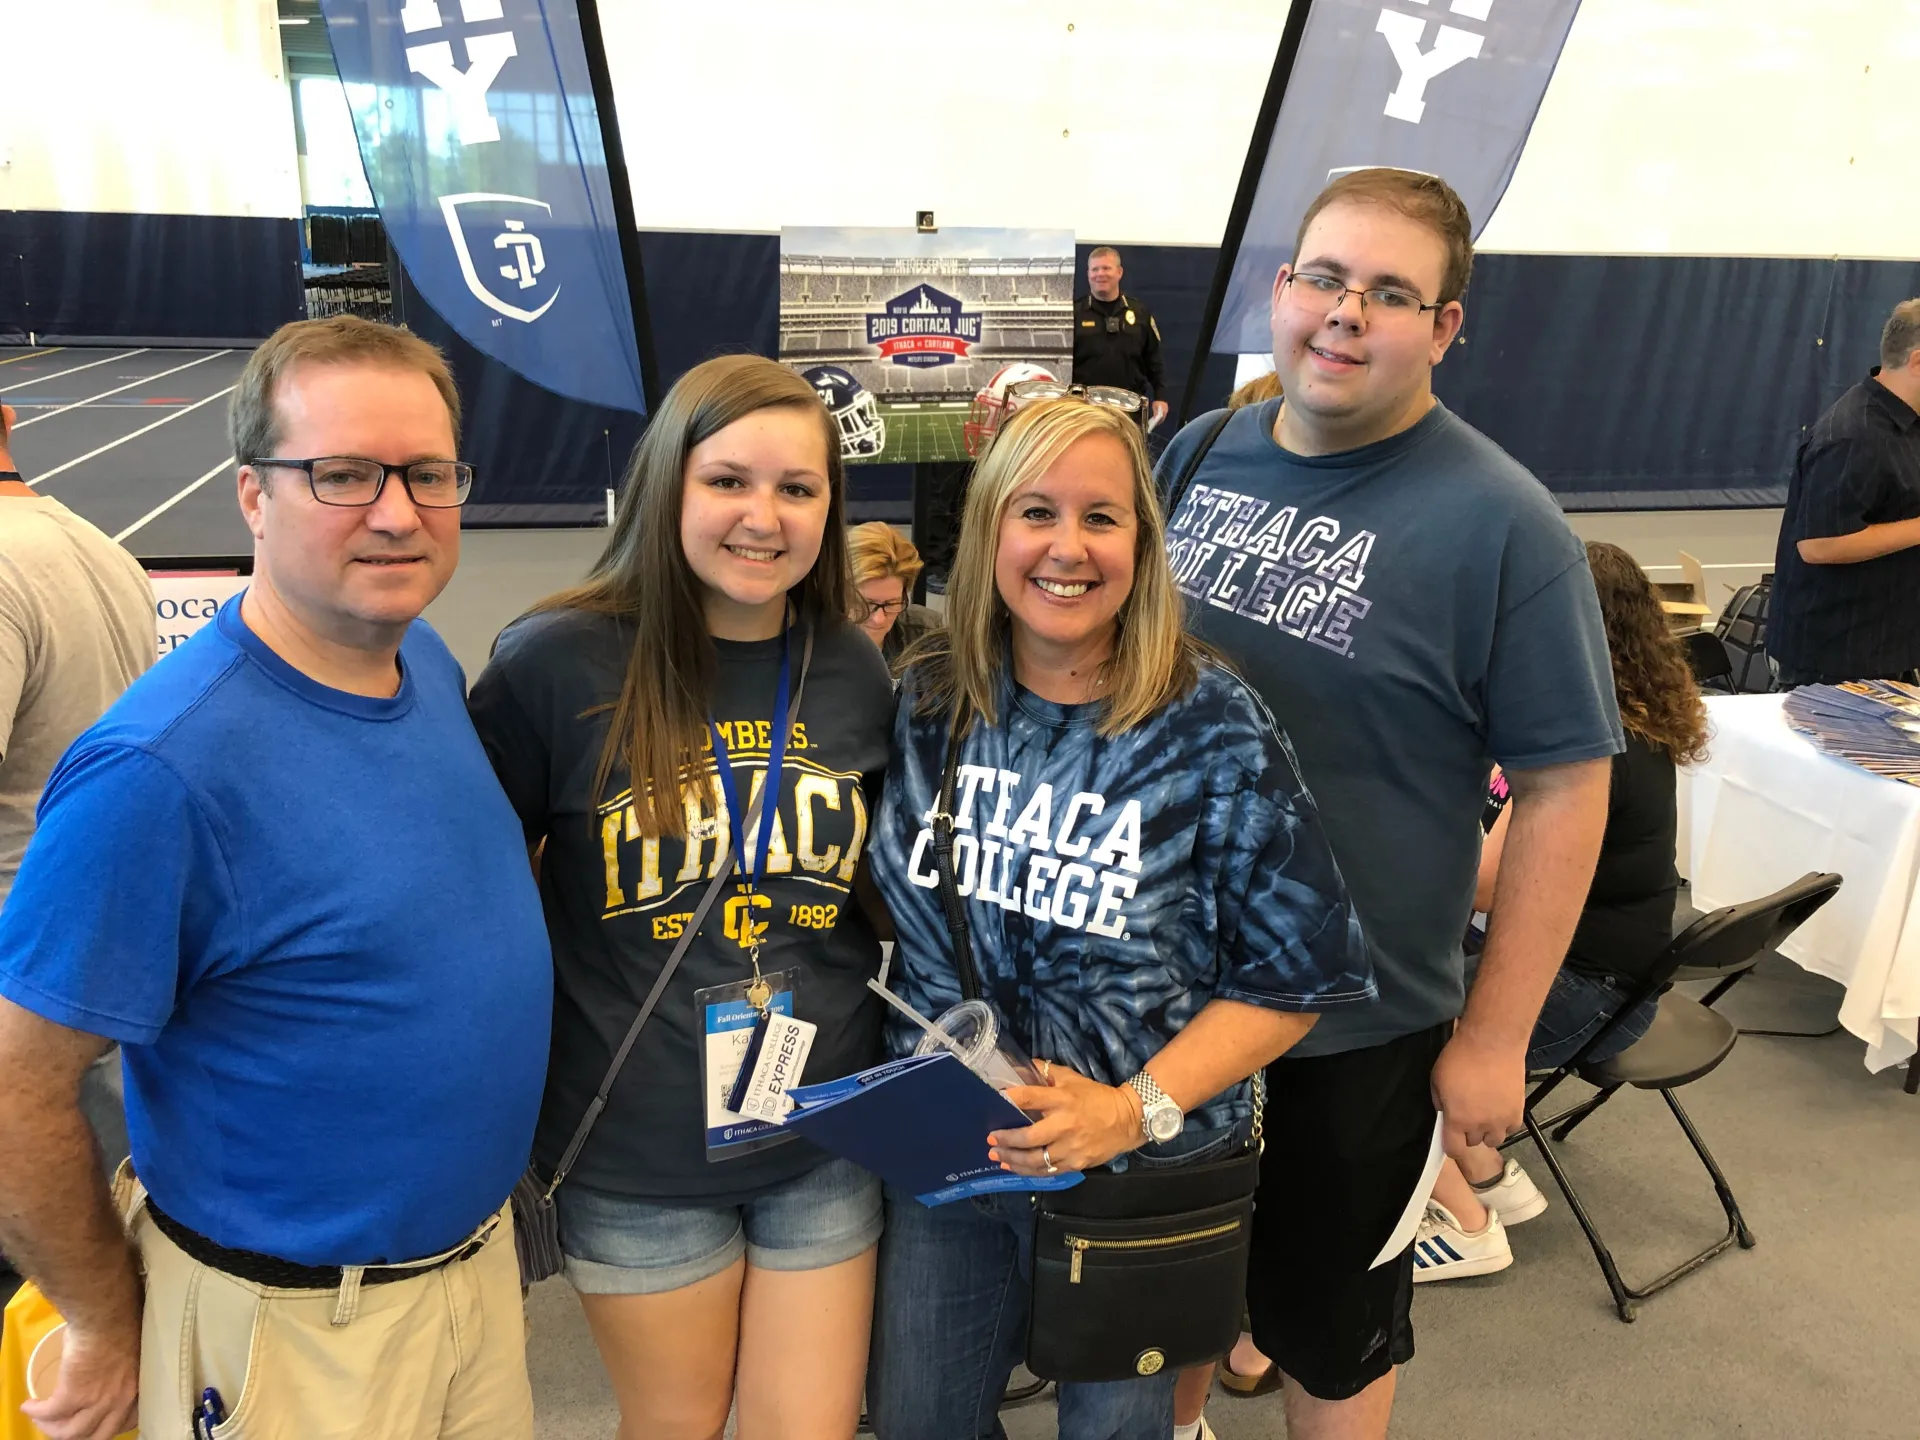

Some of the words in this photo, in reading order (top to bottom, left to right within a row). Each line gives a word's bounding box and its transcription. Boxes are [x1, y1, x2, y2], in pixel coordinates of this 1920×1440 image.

[872, 318, 898, 338] 2019
[901, 317, 951, 334] CORTACA
[893, 340, 915, 350] ITHACA
[924, 339, 955, 350] CORTLAND
[1173, 483, 1377, 591] ITHACA
[788, 904, 839, 929] 1892
[717, 1015, 731, 1024] Fall
[754, 1062, 770, 1096] ITHACA
[766, 1021, 783, 1060] COLLEGE
[768, 1024, 800, 1095] EXPRESS
[761, 1096, 777, 1117] ID
[734, 1126, 758, 1137] ITHACA
